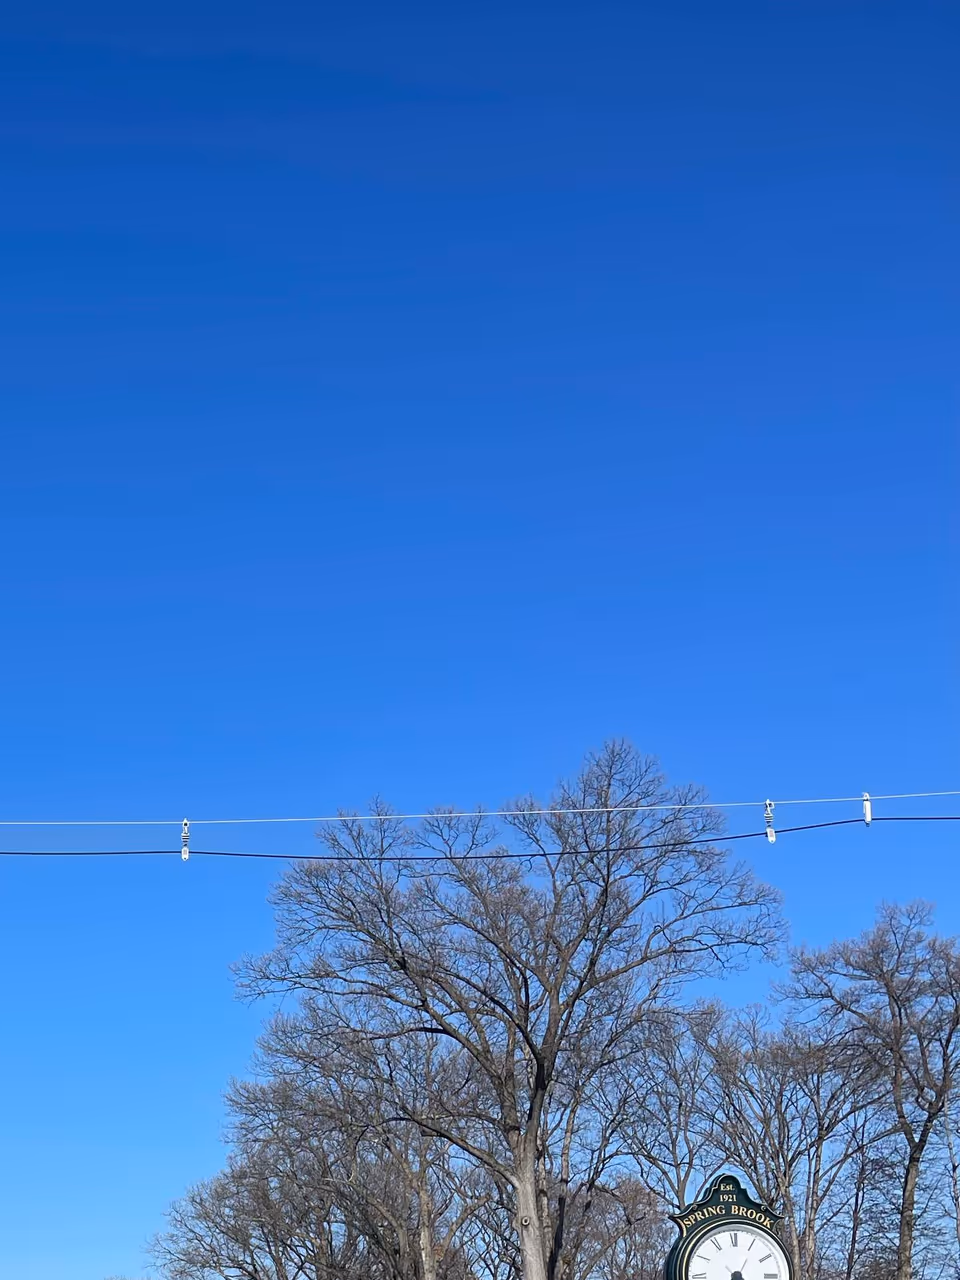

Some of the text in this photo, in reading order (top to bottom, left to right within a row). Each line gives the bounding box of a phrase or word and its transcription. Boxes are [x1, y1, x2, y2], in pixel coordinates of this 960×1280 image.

[720, 1183, 736, 1191] Est.
[719, 1194, 737, 1202] 1921
[683, 1205, 774, 1228] SPRING BROOK
